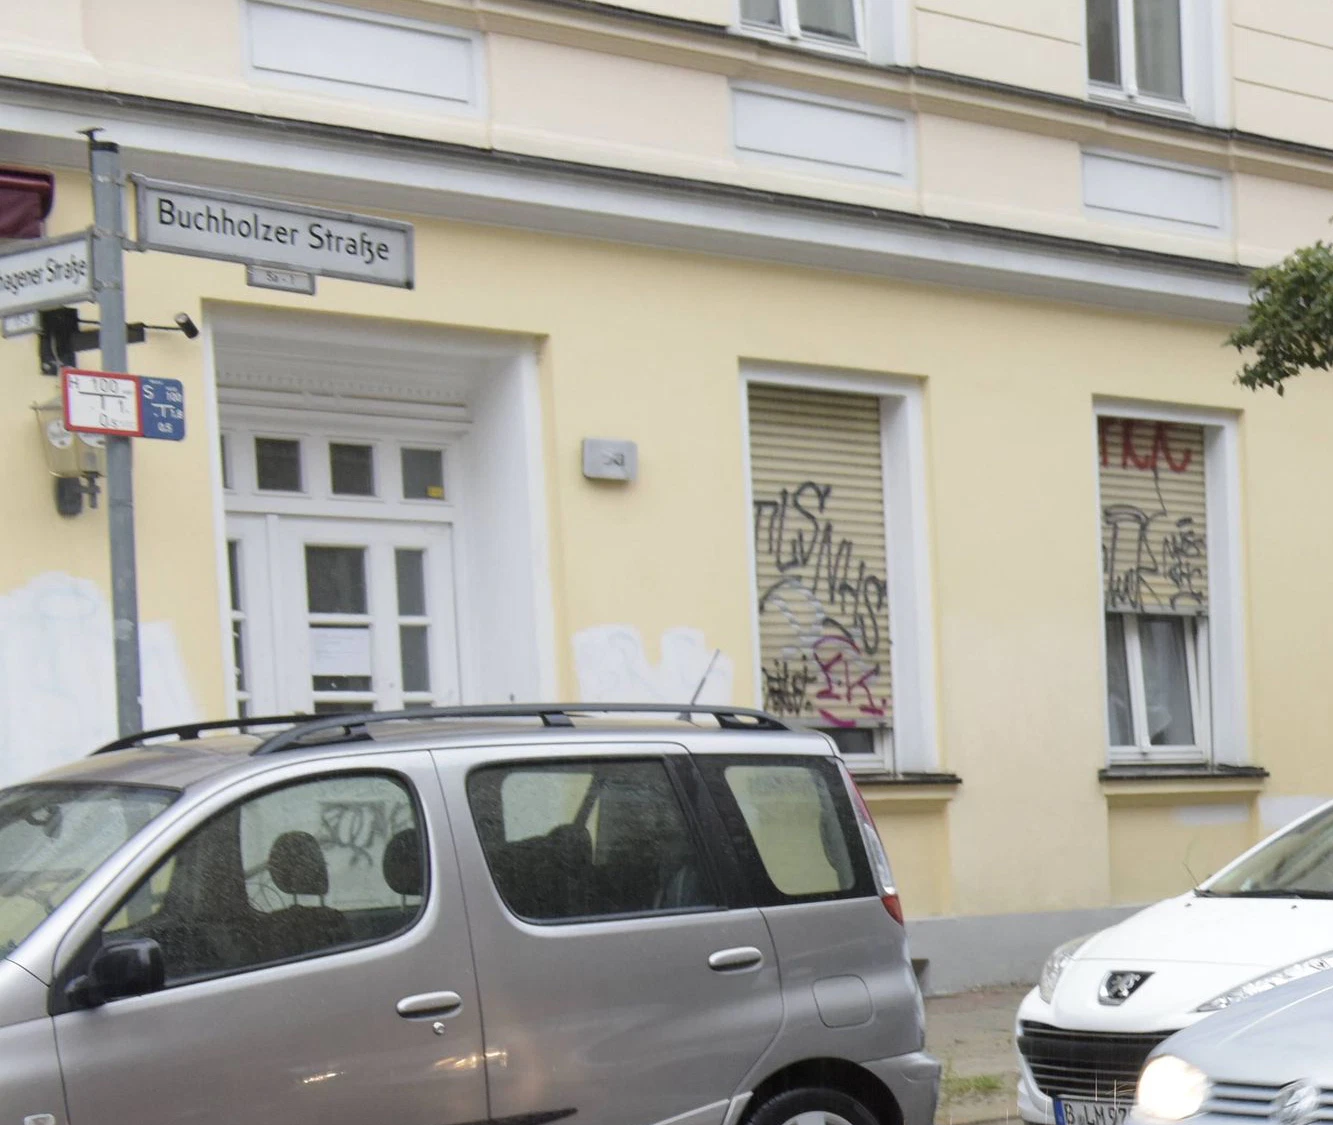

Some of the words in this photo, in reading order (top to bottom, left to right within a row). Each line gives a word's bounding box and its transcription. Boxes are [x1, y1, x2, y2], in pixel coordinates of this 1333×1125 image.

[157, 197, 299, 246] Buchholzer
[307, 223, 390, 264] Straße
[46, 254, 86, 286] Straße
[92, 378, 119, 394] 100
[142, 384, 156, 400] S
[1063, 1102, 1076, 1125] B
